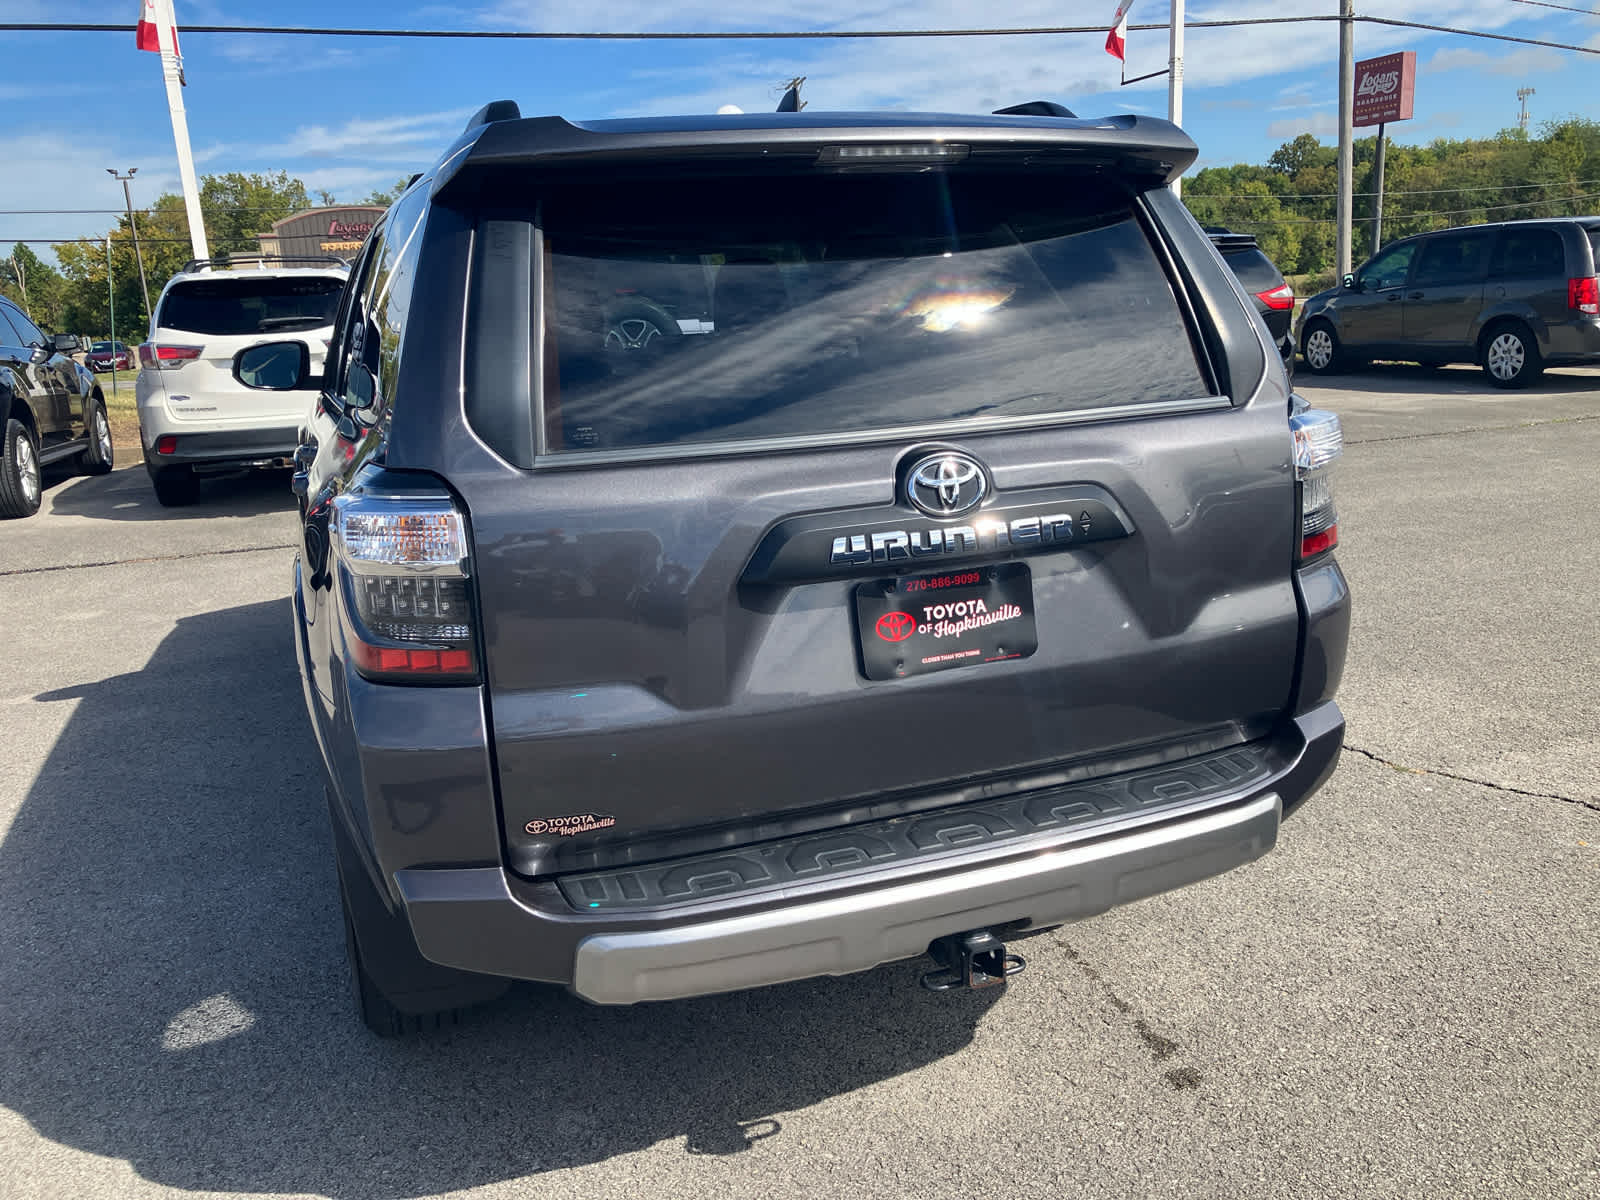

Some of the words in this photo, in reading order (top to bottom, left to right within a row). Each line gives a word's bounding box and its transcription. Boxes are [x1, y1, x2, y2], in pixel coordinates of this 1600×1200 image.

[829, 513, 1074, 565] 4RUNNER
[906, 572, 980, 592] 270-886-9099
[923, 598, 987, 621] TOYOTA
[918, 623, 933, 634] OF
[933, 603, 1022, 638] Hopkinsville
[547, 814, 595, 827] TOYOTA
[559, 817, 616, 836] Hopkinsville
